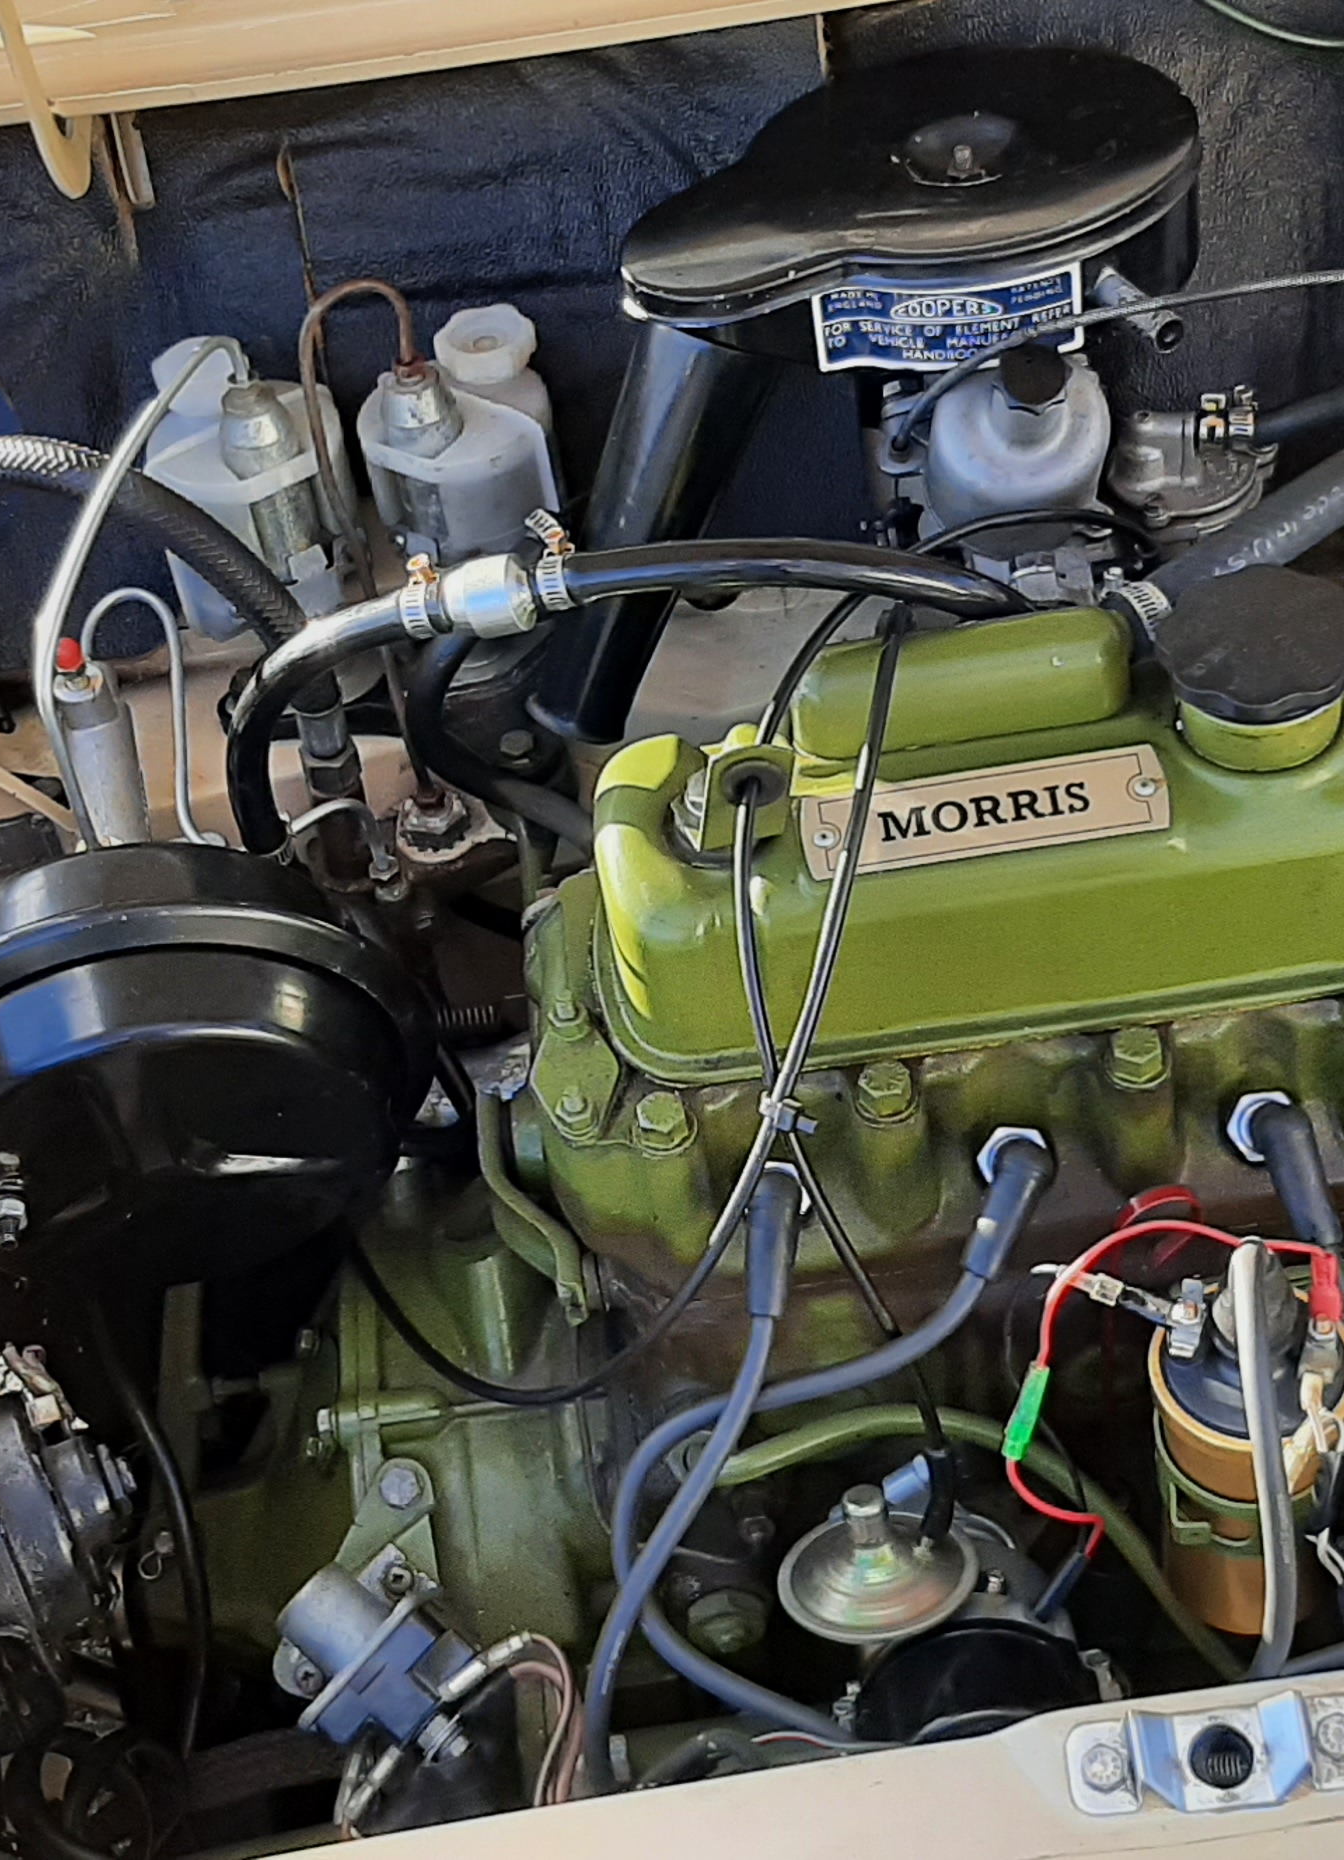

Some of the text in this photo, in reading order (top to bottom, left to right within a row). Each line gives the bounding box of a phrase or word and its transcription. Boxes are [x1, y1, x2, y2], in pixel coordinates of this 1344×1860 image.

[824, 321, 852, 336] FOR
[858, 321, 913, 336] SERVICE
[923, 325, 943, 337] OF
[955, 318, 1020, 336] ELEMENT
[827, 335, 846, 349] TO
[868, 333, 925, 349] VEHICLE
[902, 348, 979, 360] HANDBOO
[877, 782, 1090, 841] MORRIS
